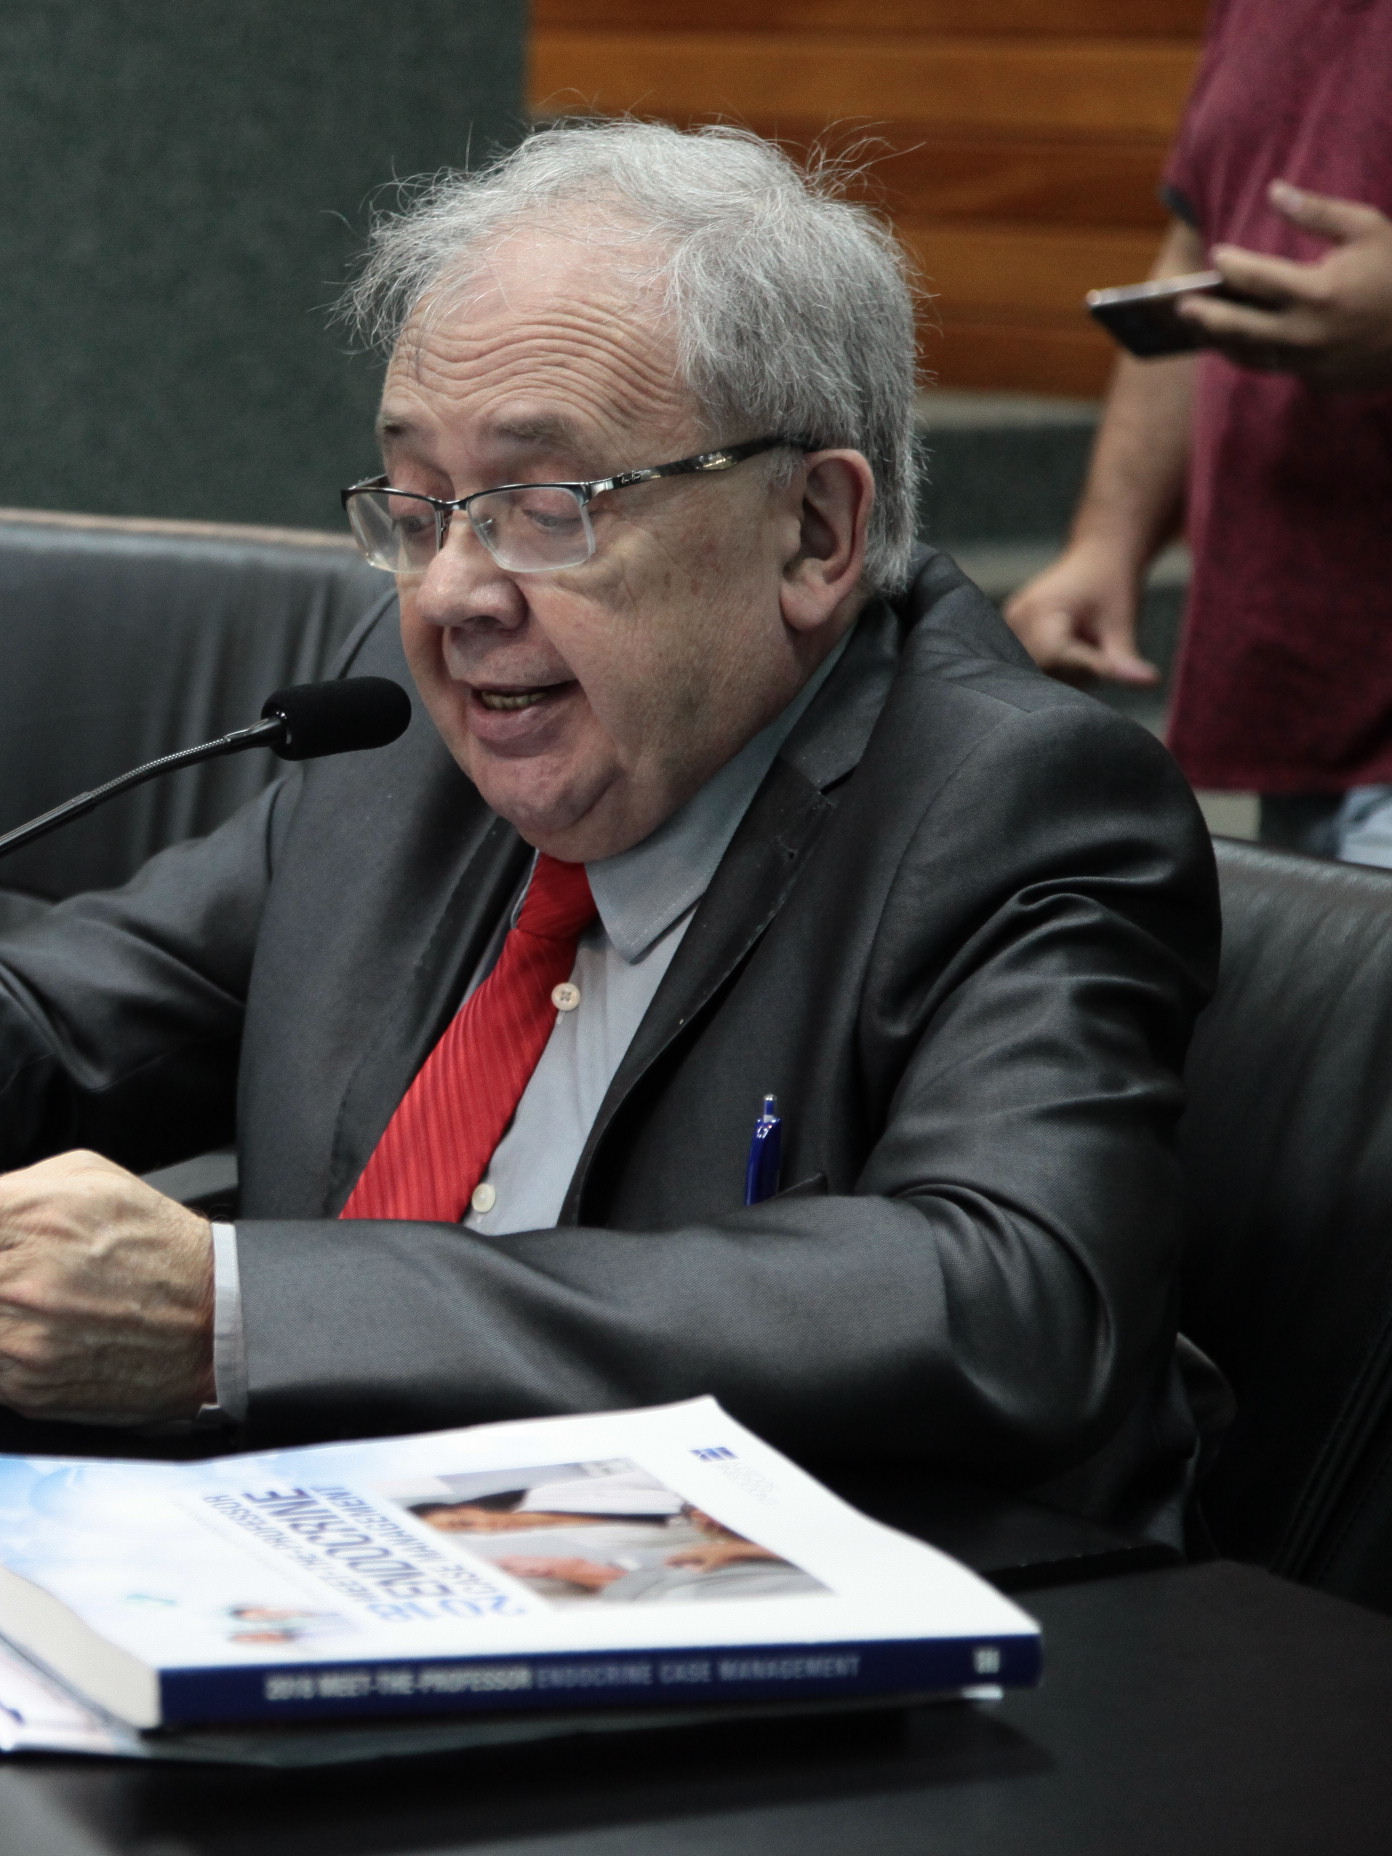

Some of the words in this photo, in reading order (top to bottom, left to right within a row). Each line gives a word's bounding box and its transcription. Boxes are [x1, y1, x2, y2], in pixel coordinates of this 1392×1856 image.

[241, 1487, 456, 1599] ENDOCRINE
[310, 1485, 446, 1562] MANAGEMENT
[717, 1655, 860, 1682] MANAGEMENT
